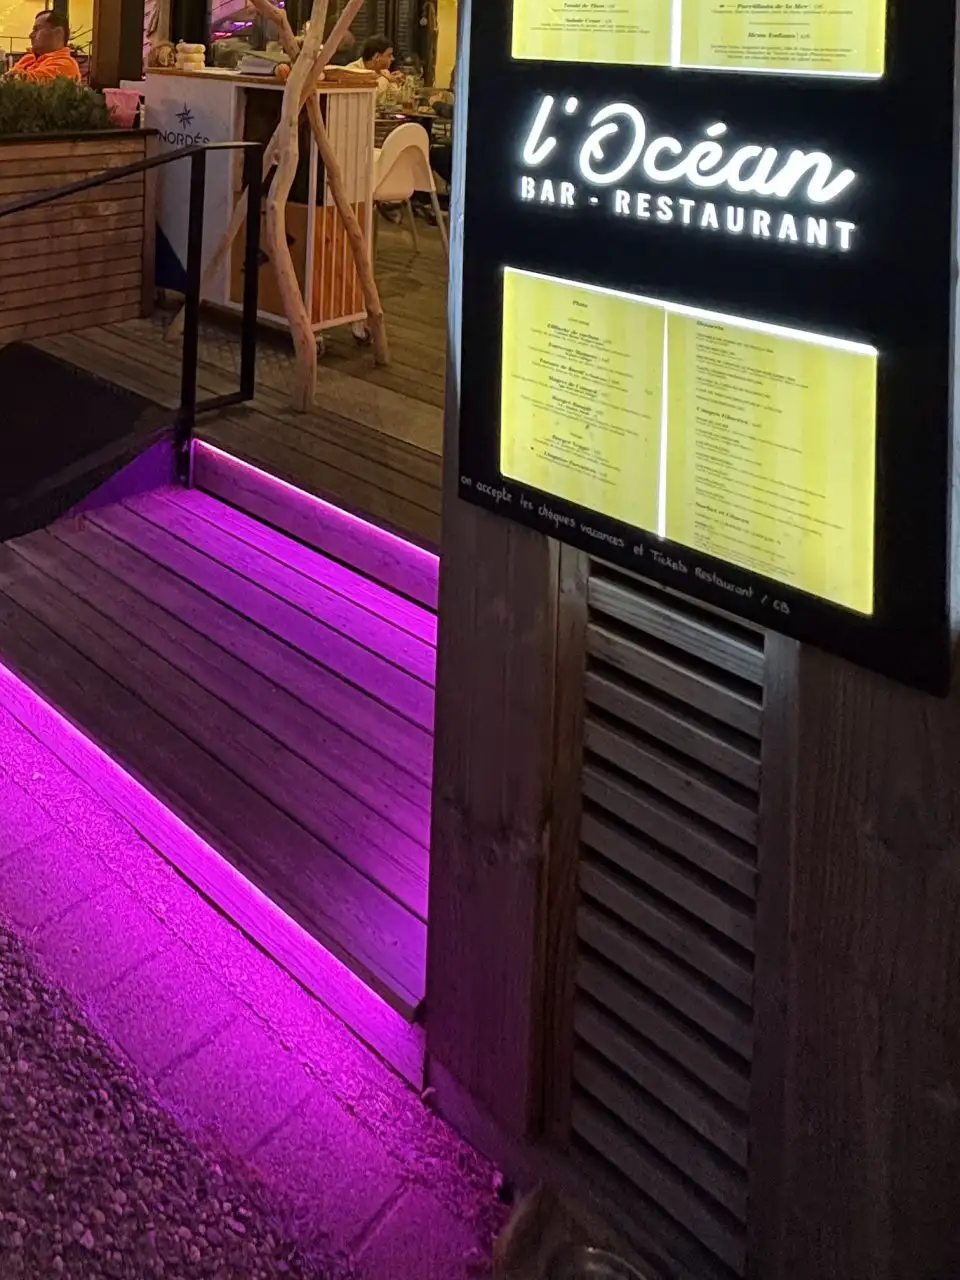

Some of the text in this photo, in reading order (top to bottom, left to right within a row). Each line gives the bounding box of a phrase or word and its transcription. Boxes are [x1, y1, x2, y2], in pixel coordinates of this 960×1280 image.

[522, 95, 856, 203] l'Océan
[520, 175, 575, 207] BAR
[615, 190, 856, 251] RESTAURANT
[460, 475, 472, 486] on
[476, 481, 513, 504] accepte
[520, 494, 534, 510] les
[580, 523, 625, 548] vacances
[633, 543, 644, 556] et
[695, 566, 754, 599] Restaurant
